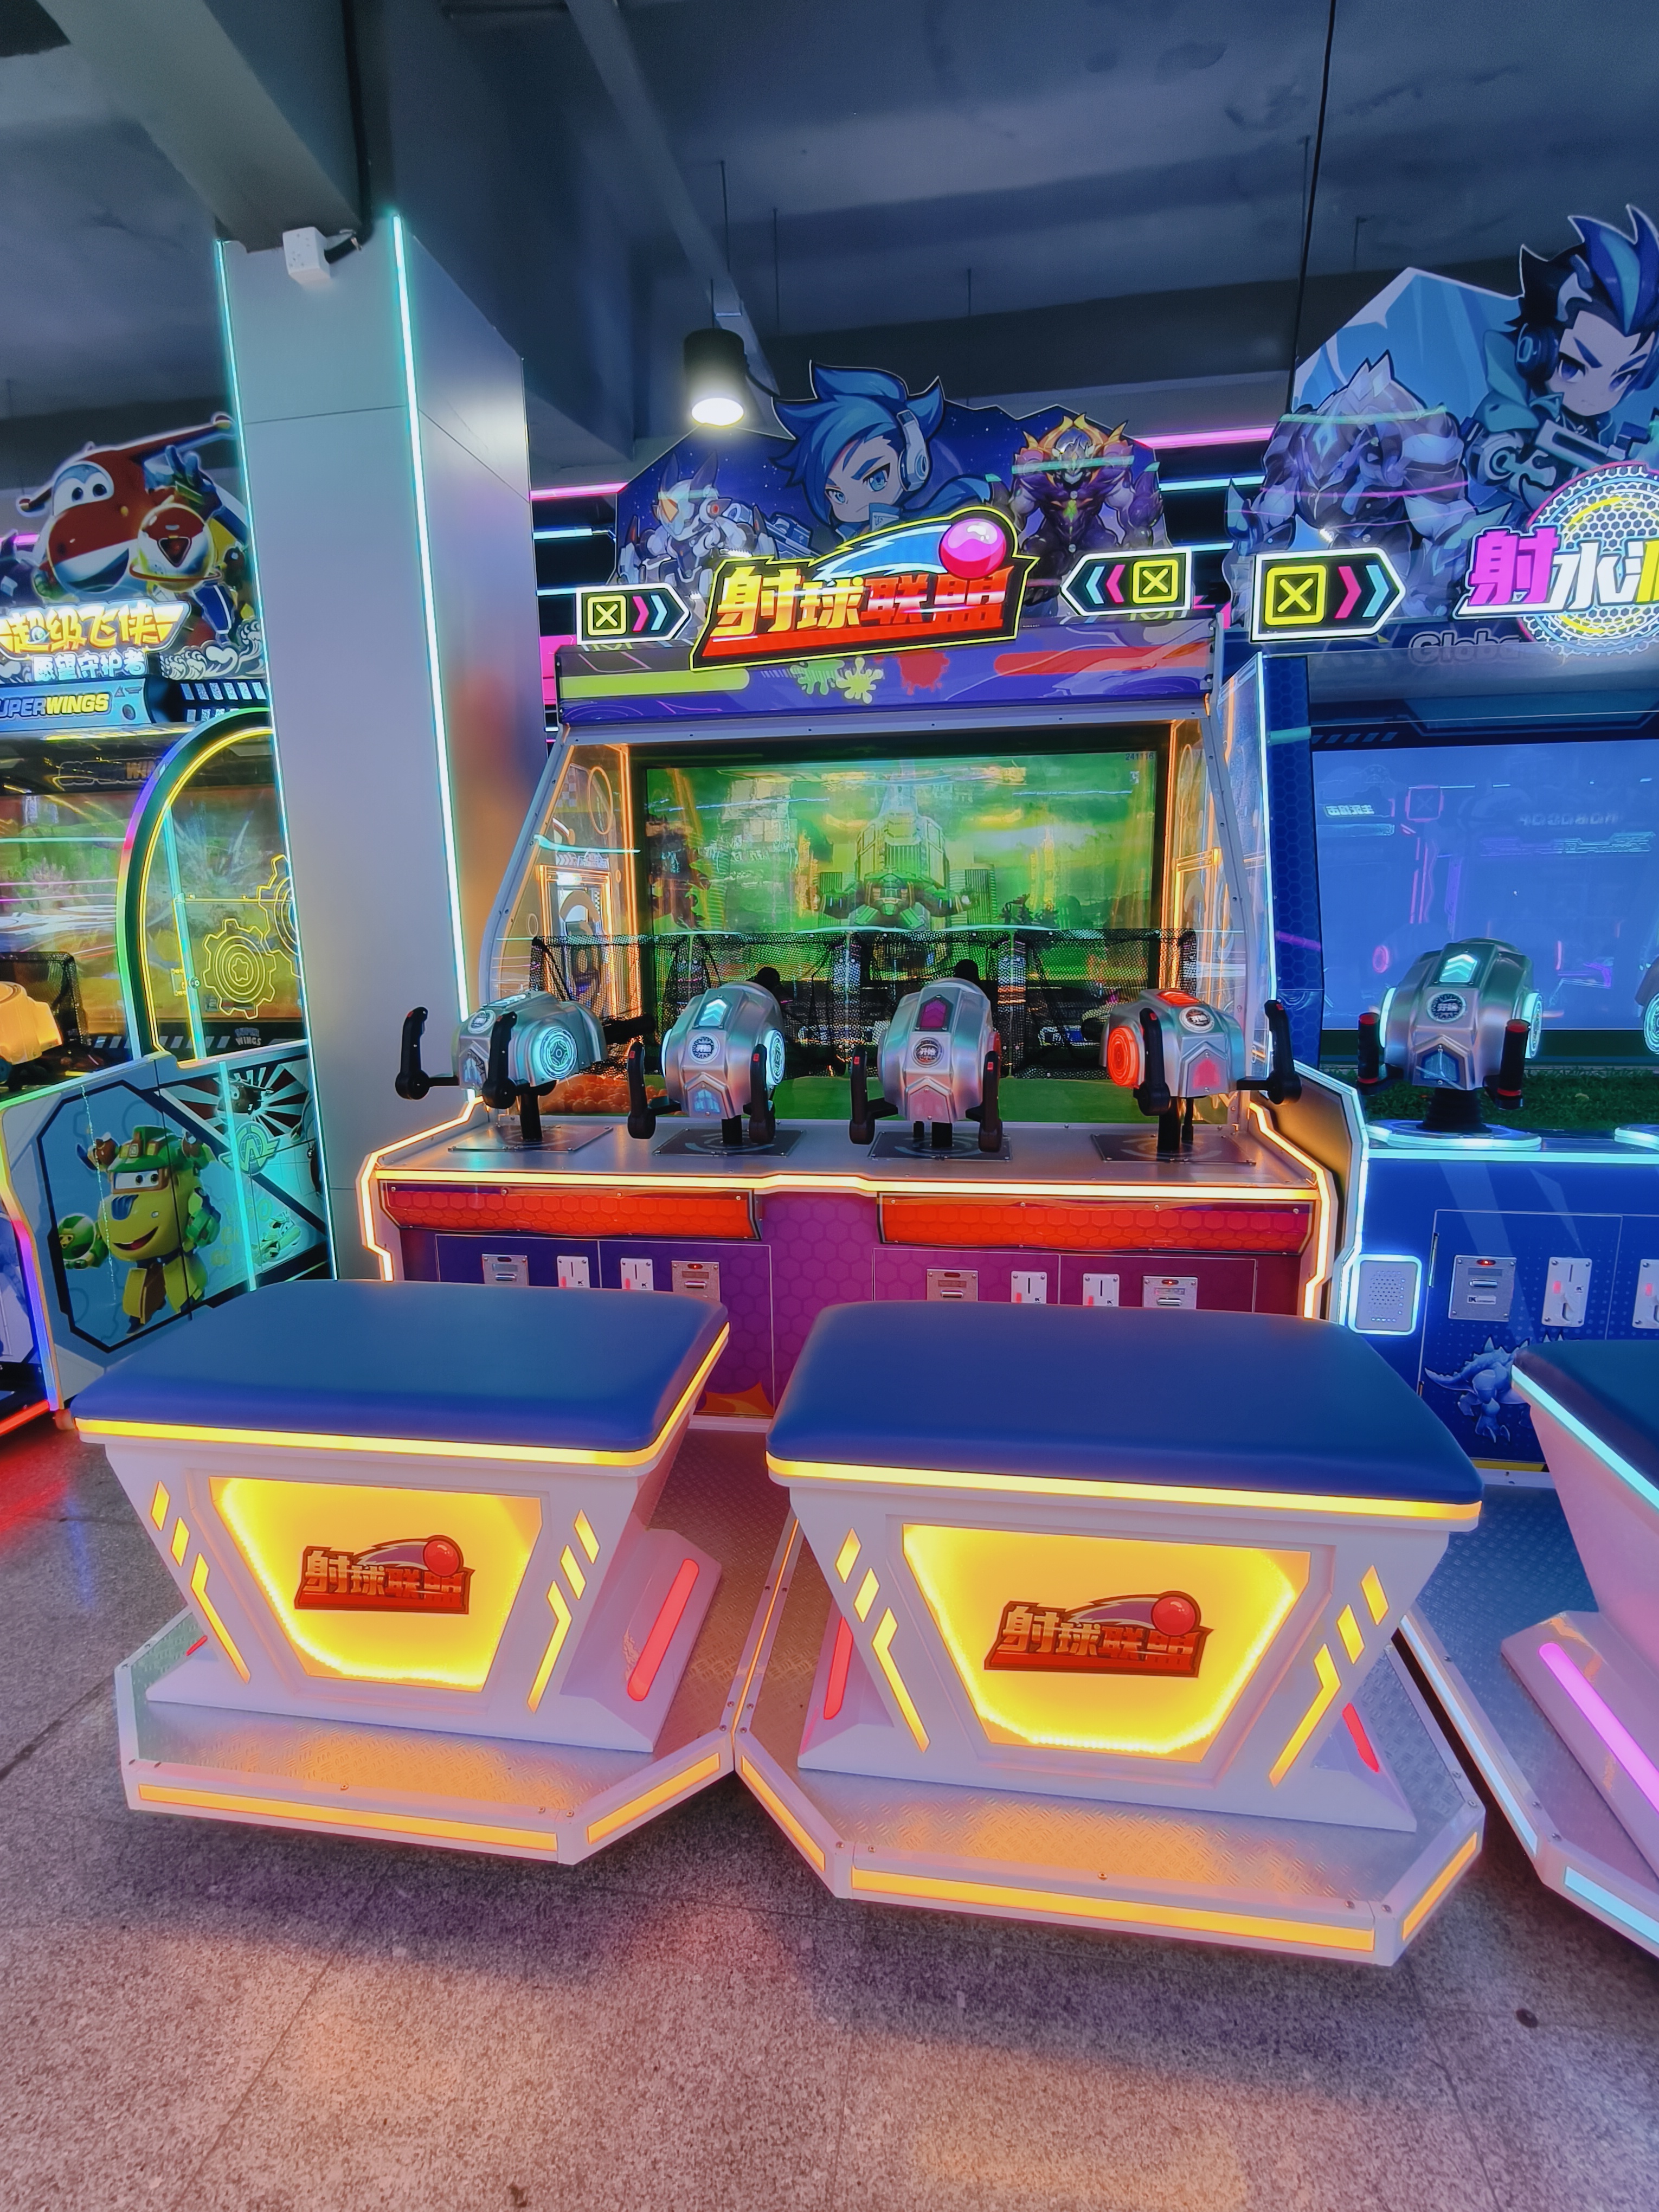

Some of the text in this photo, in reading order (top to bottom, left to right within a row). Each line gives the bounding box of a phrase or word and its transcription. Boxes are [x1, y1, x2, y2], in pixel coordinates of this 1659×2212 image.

[8, 601, 162, 653] 超级飞侠
[710, 565, 1014, 638] 射球联盟
[33, 648, 146, 681] 愿望守护者
[235, 1036, 262, 1045] WINGS
[302, 1549, 465, 1604] 射球联盟
[996, 1605, 1200, 1665] 射球联盟
